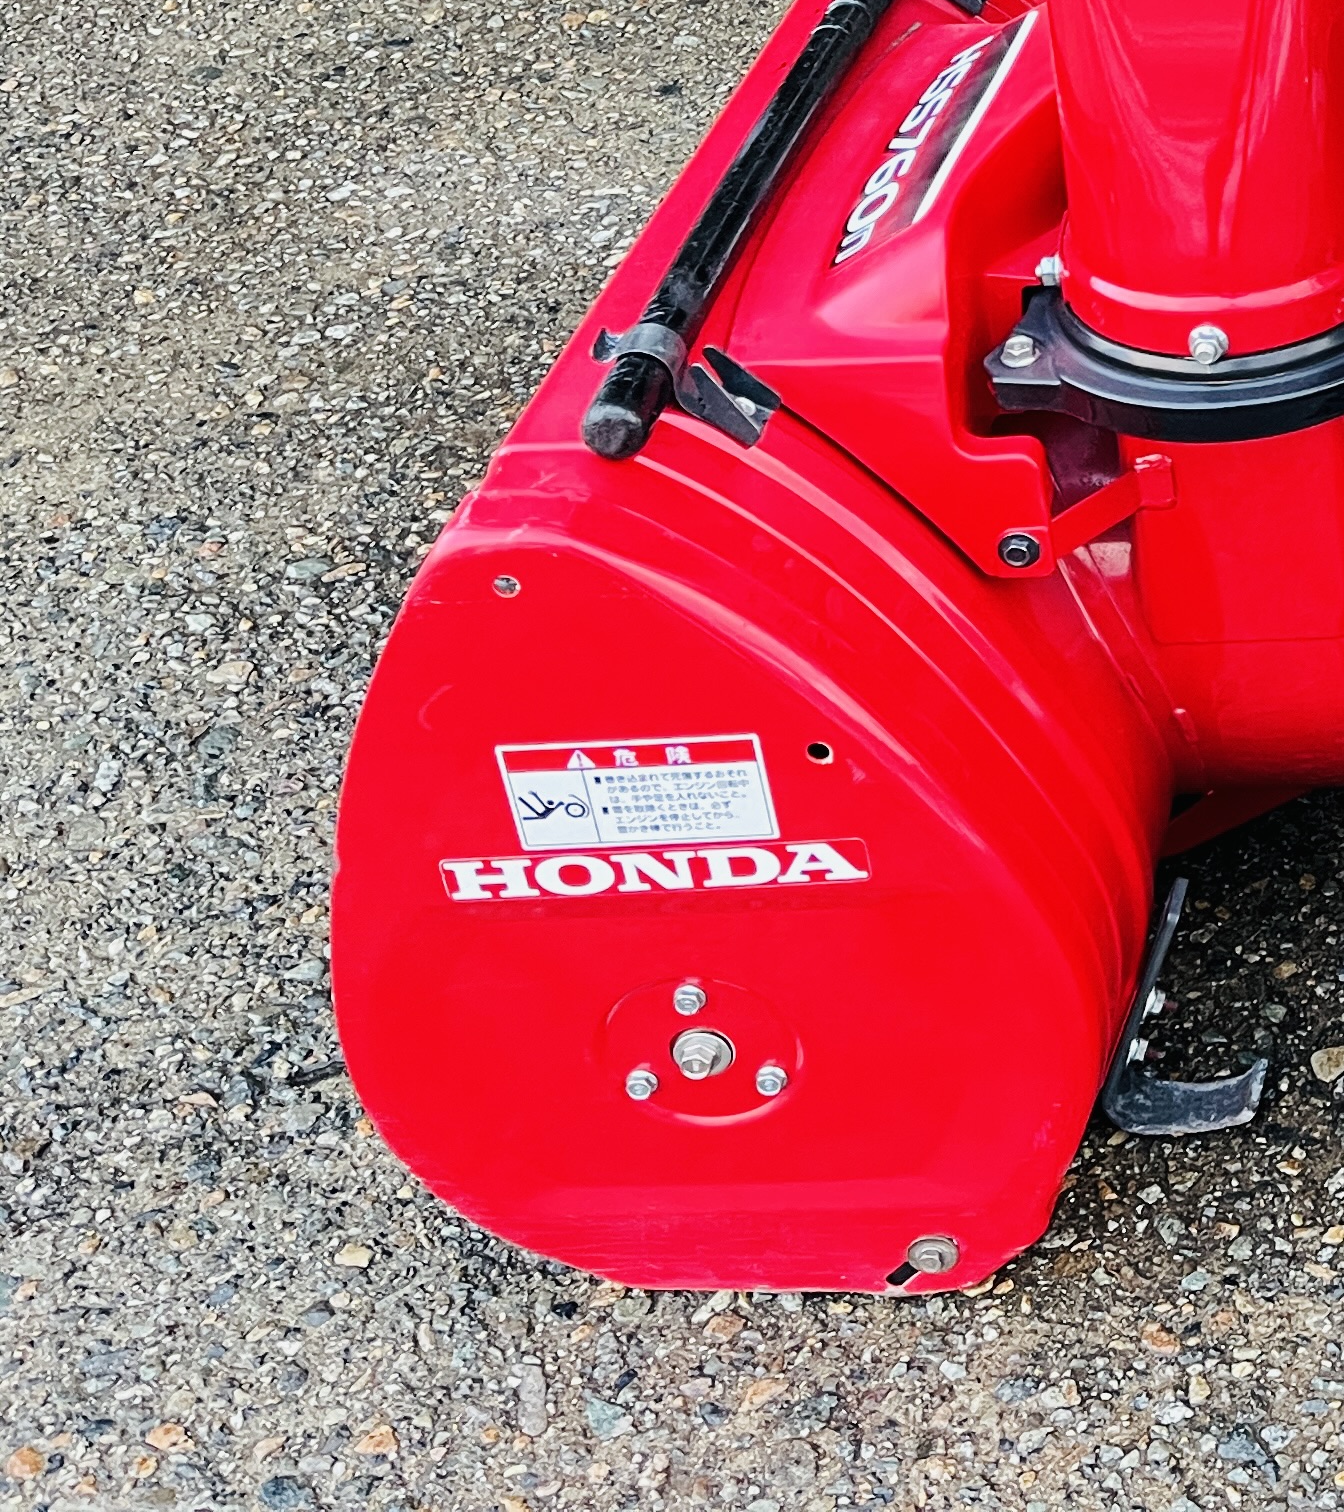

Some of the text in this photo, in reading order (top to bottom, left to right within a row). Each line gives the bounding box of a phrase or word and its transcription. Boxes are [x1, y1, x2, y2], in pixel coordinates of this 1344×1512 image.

[834, 35, 995, 264] HSS760n
[612, 745, 692, 768] 危険
[604, 768, 749, 784] 巻き込まれて死するおそれ
[617, 821, 722, 835] 雪かきで行うこと。
[451, 841, 869, 901] HONDA
